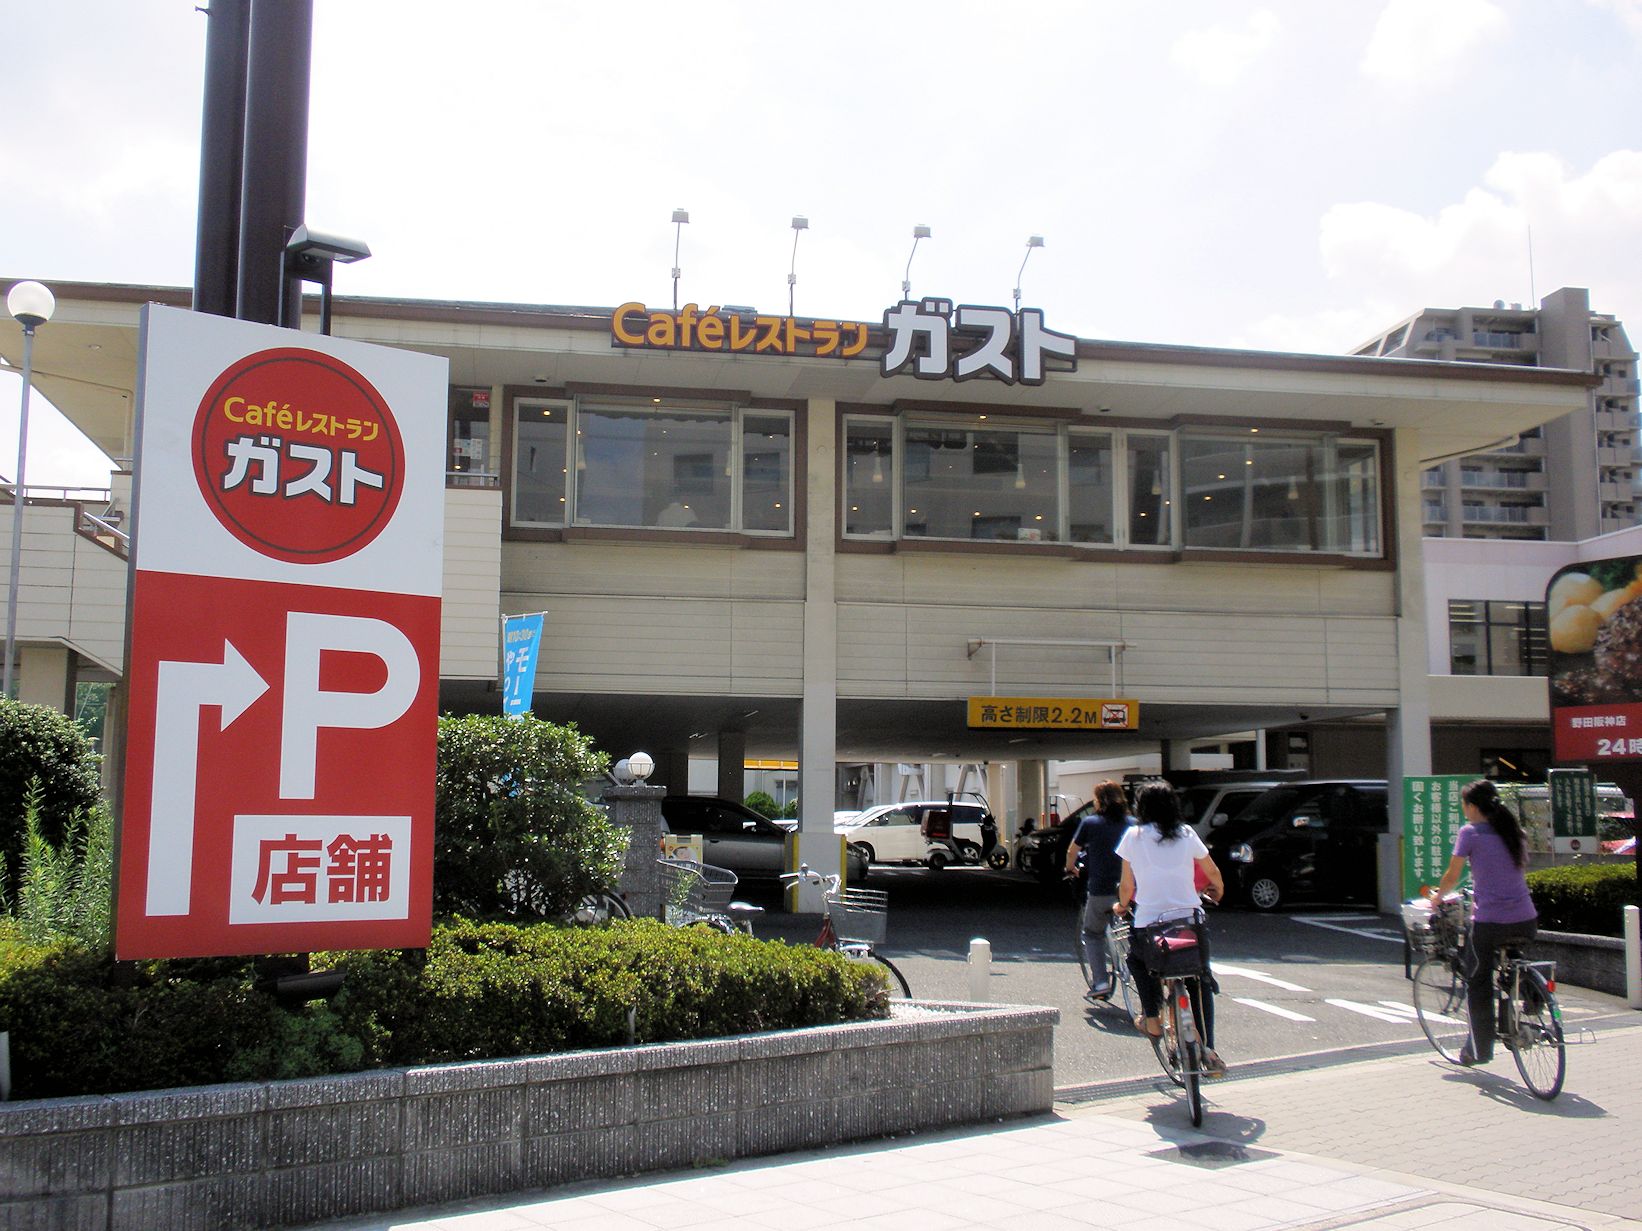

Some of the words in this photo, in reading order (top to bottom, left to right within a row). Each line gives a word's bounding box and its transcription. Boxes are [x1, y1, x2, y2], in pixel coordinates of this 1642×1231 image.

[611, 301, 869, 357] Caféレストラン
[882, 298, 1078, 385] ガスト
[223, 396, 379, 441] Caféレストラン
[222, 435, 384, 505] ガスト
[279, 611, 421, 800] P
[981, 705, 1097, 725] 高さ制限2.2M
[1571, 715, 1627, 729] 野田阪神店
[251, 833, 393, 906] 店舗
